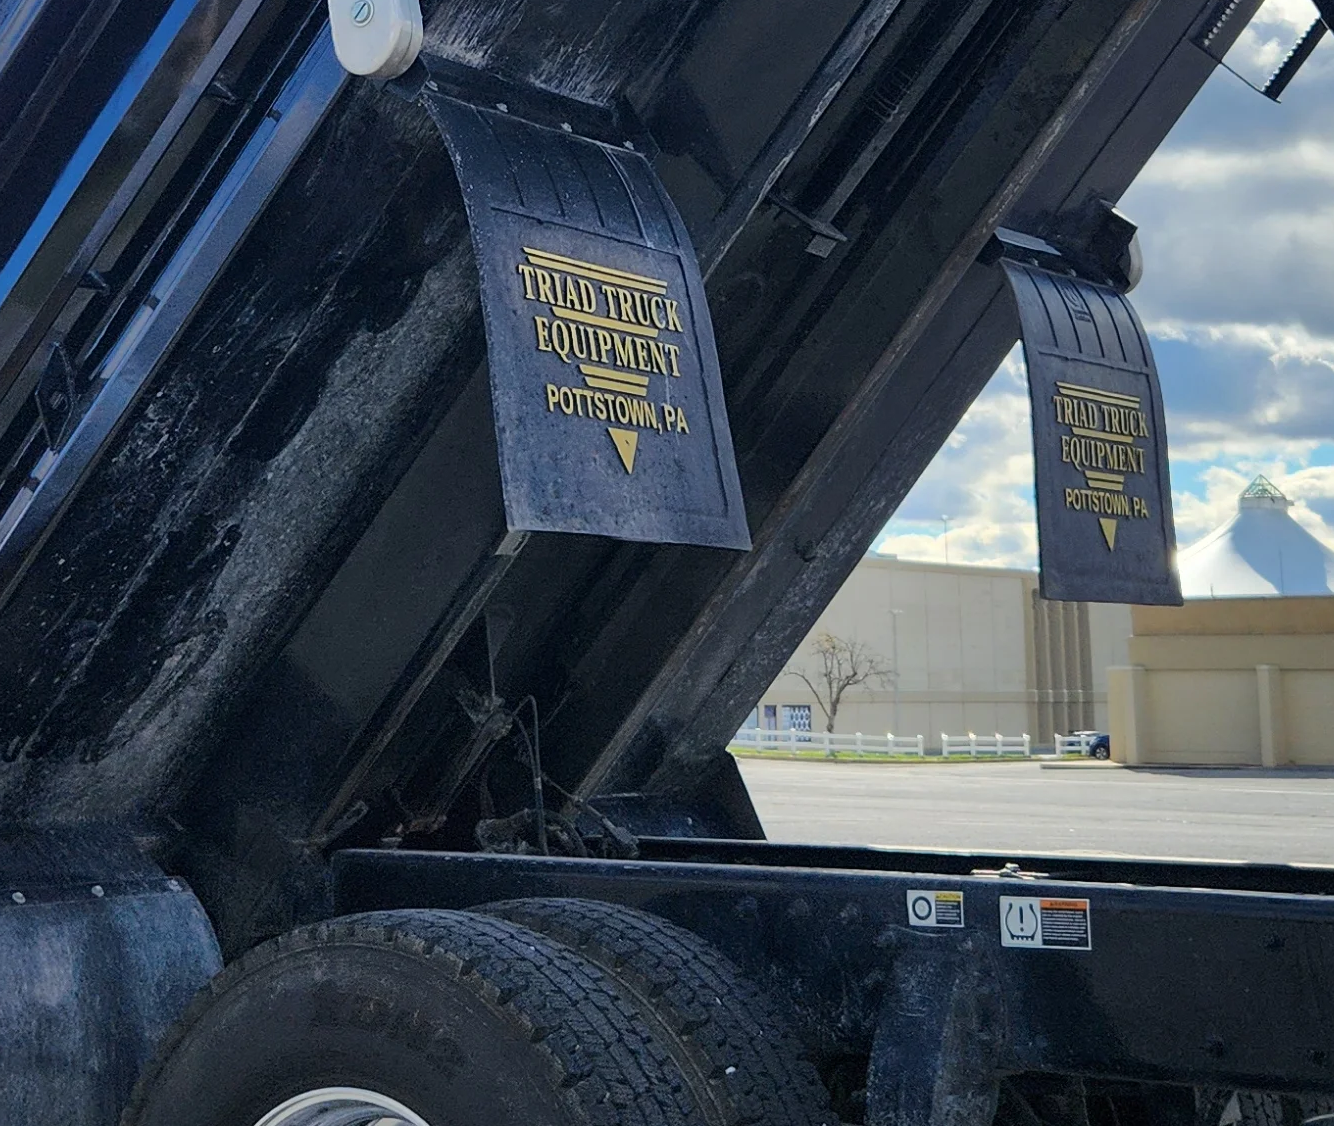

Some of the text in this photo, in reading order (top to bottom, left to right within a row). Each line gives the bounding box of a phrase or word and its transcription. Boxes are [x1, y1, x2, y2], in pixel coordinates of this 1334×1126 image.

[519, 263, 683, 332] TRIAD TRUCK
[535, 315, 681, 377] EQUIPMENT
[546, 383, 690, 434] POTTSTOWN, PA
[1053, 395, 1149, 438] TRIAD TRUCK
[1061, 435, 1145, 474] EQUIPMENT
[1133, 496, 1149, 518] PA
